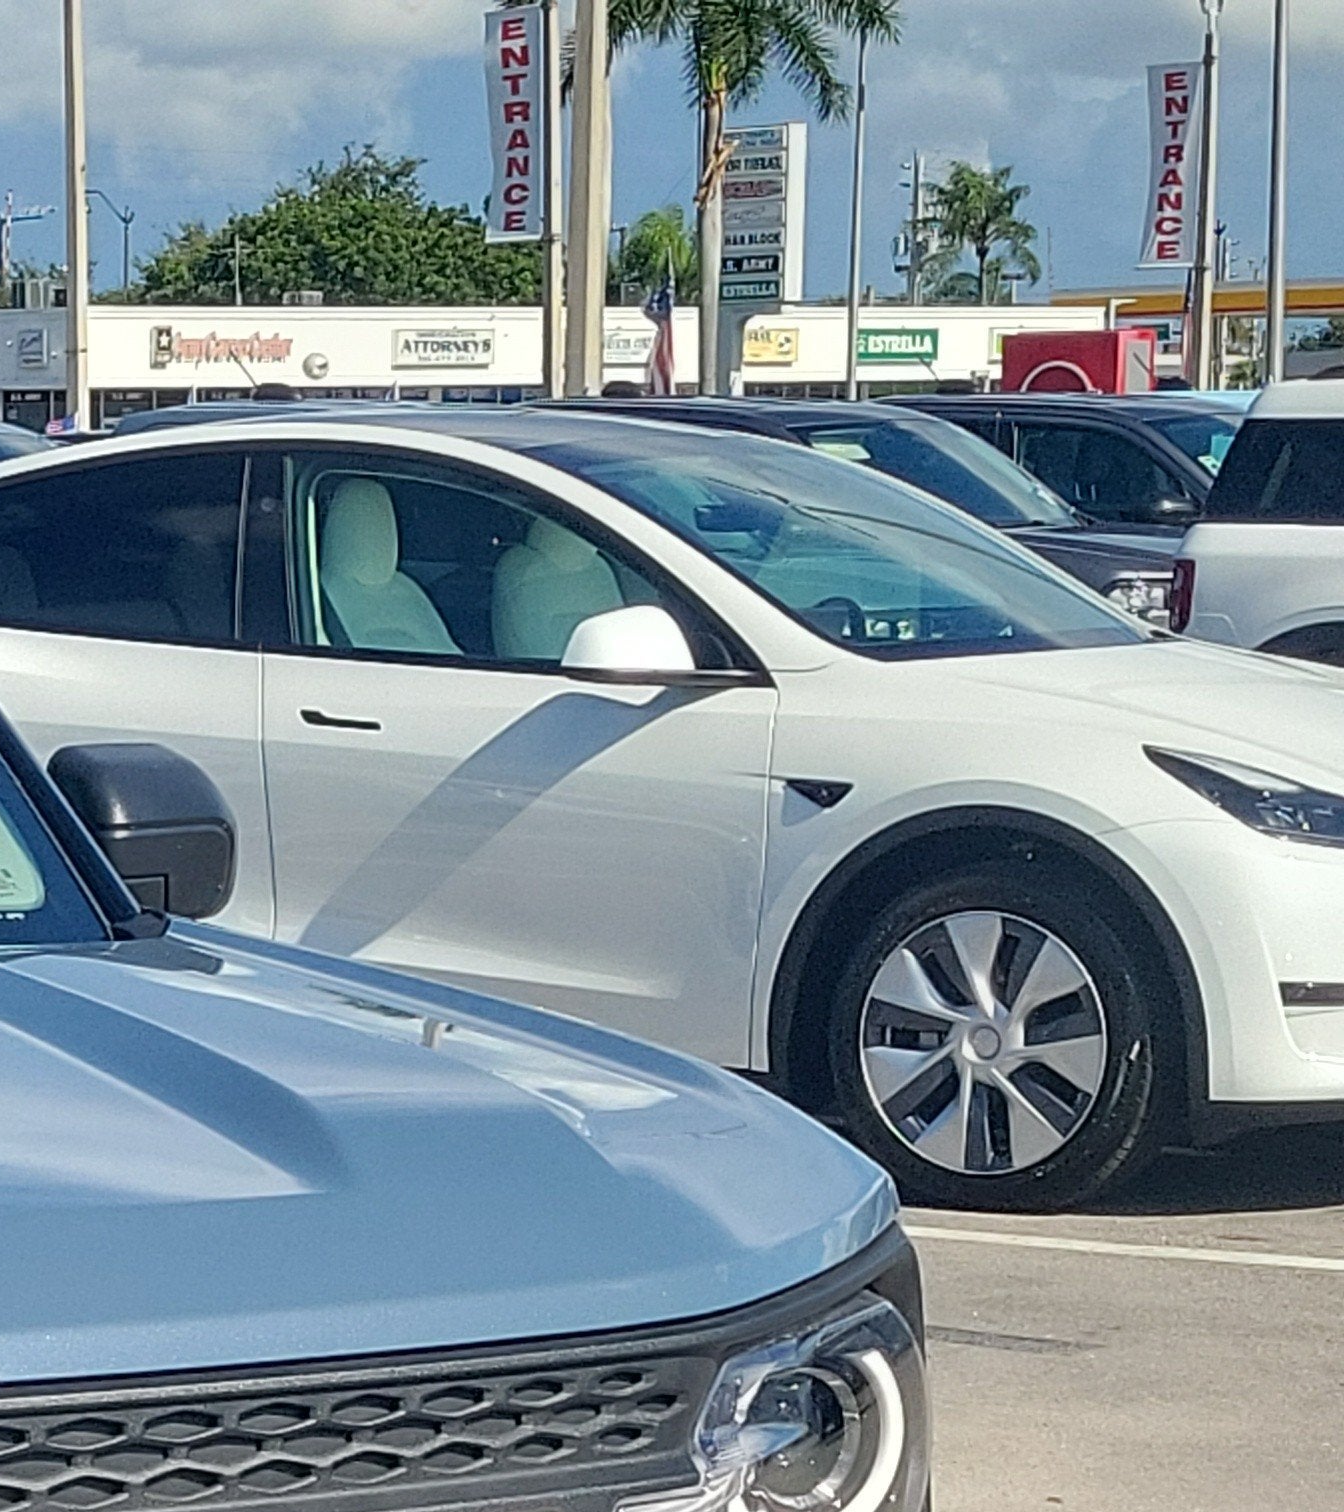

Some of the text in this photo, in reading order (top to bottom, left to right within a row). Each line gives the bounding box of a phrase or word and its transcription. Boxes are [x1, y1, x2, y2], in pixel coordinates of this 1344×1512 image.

[500, 17, 530, 232] ENTRANCE
[1154, 71, 1189, 260] ENTRANCE
[400, 338, 492, 354] ATTORNEYS
[868, 334, 933, 353] ESTRELLA
